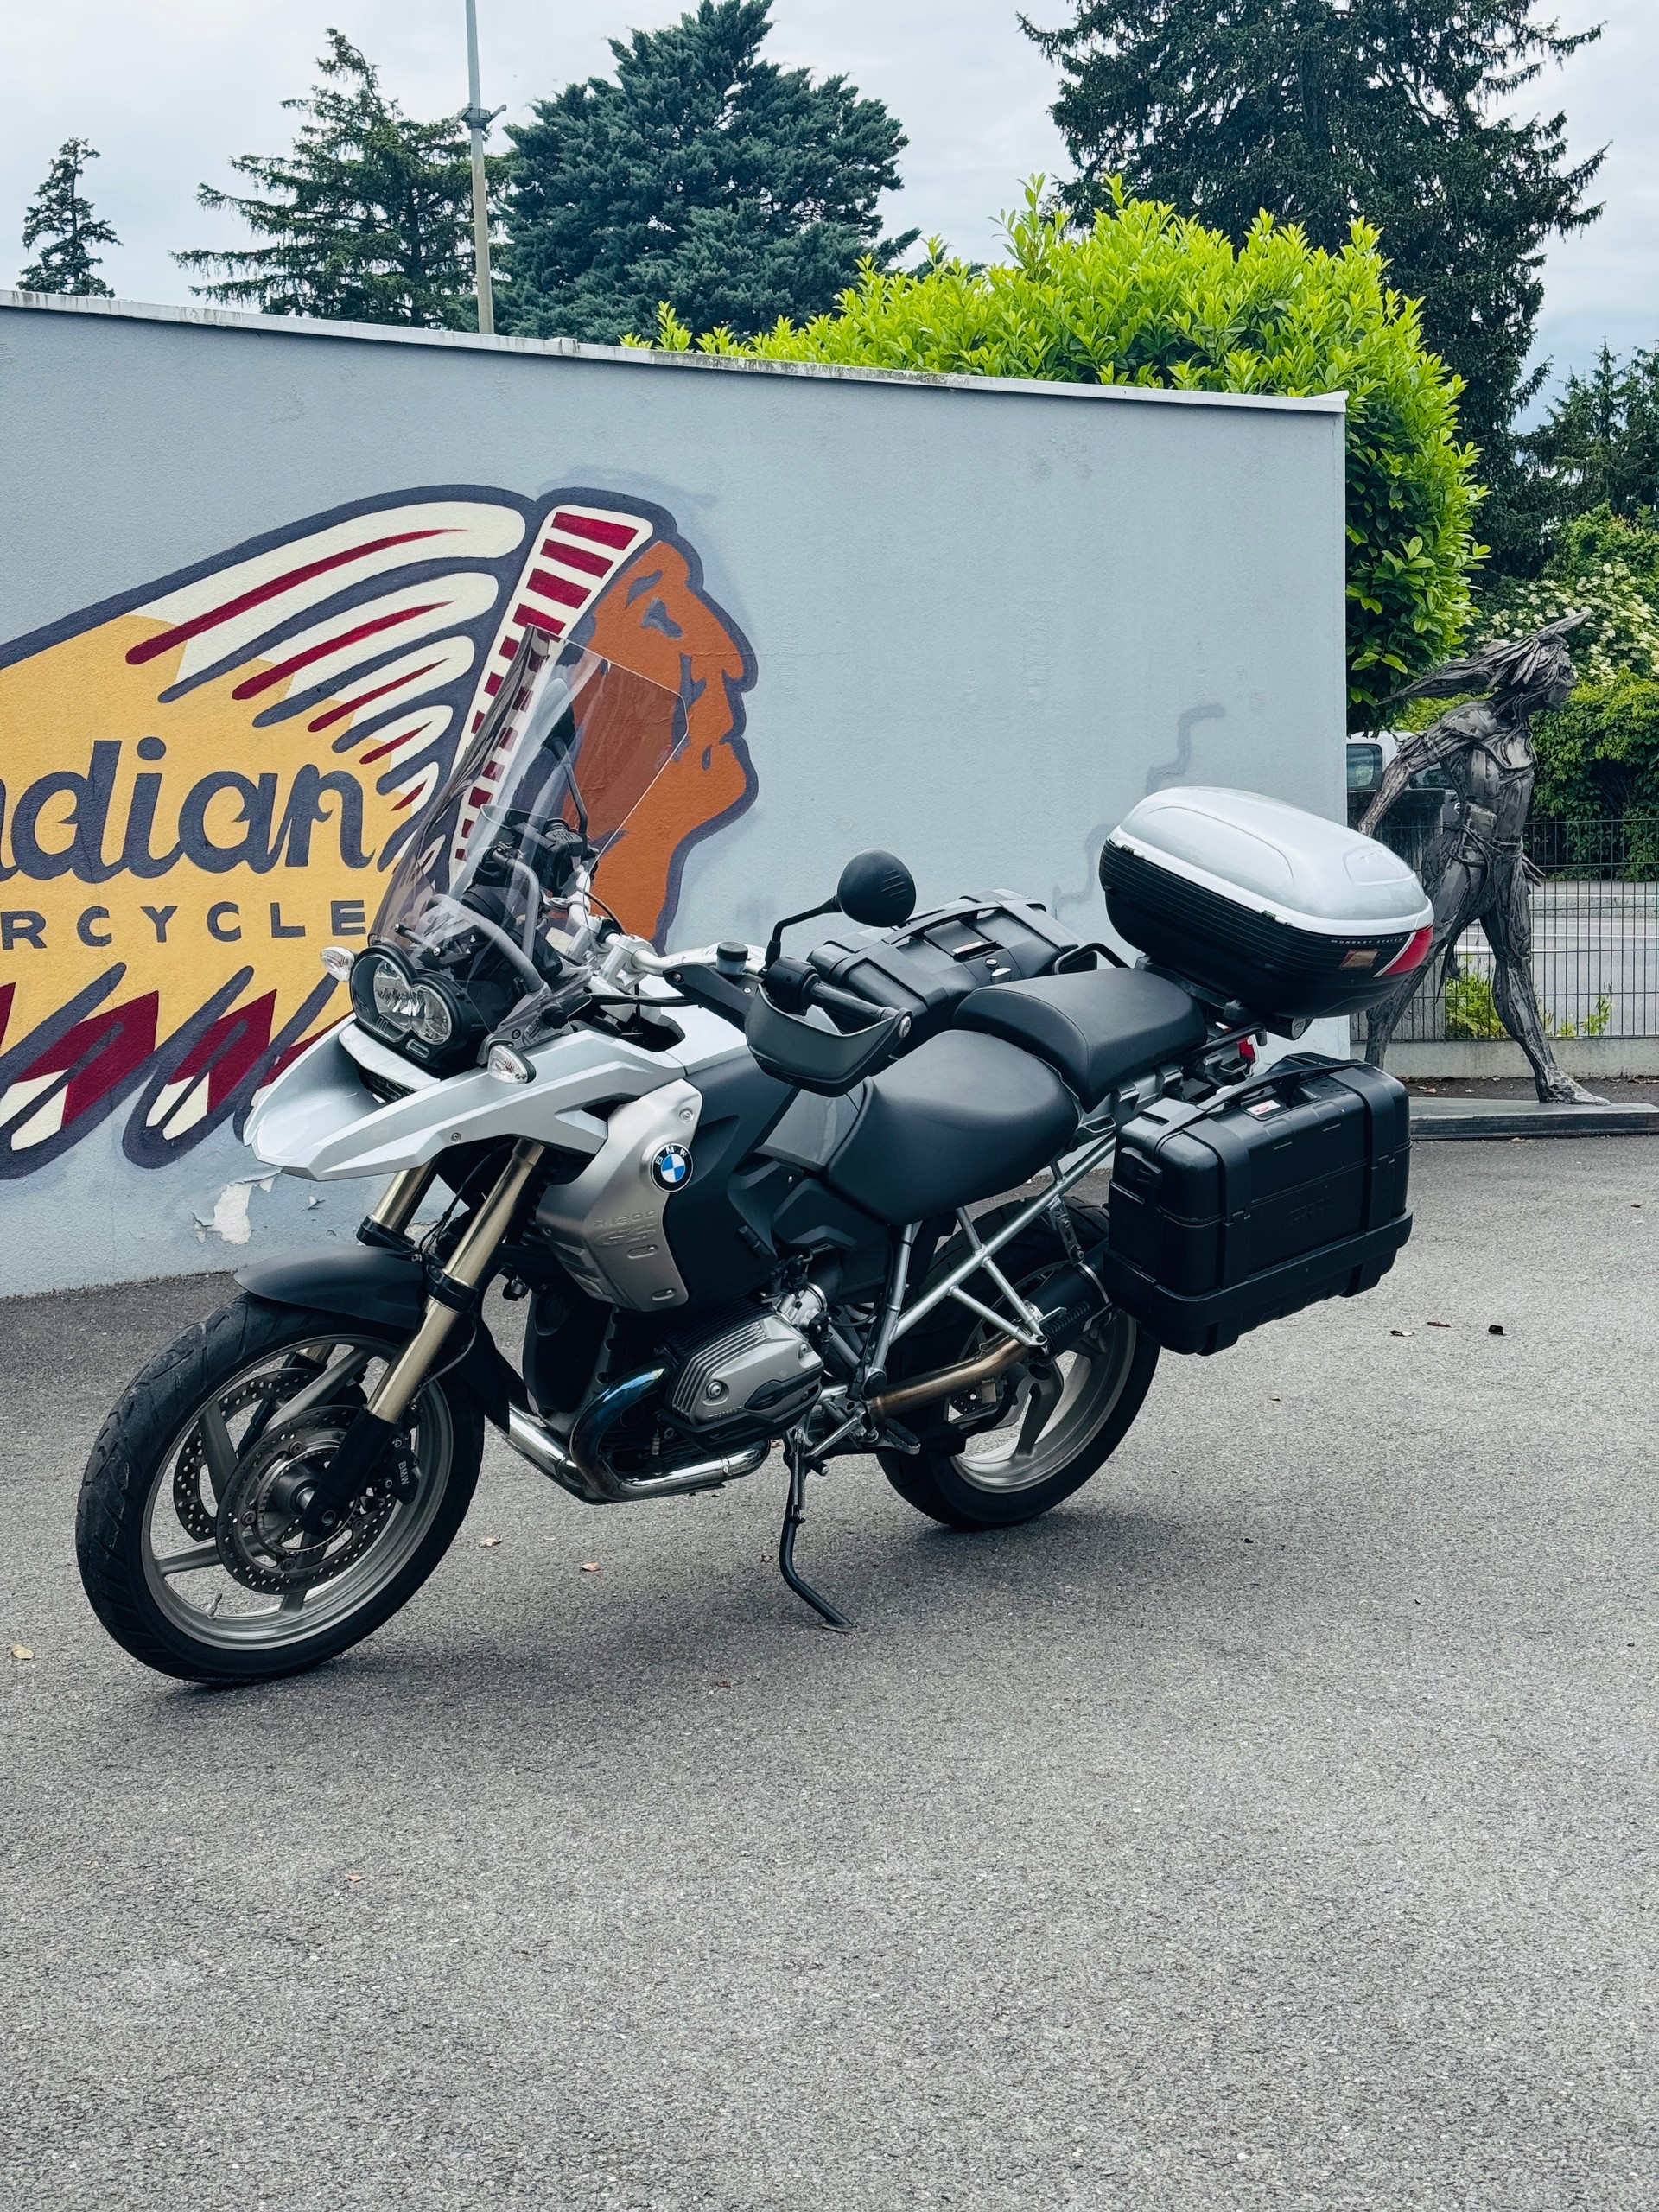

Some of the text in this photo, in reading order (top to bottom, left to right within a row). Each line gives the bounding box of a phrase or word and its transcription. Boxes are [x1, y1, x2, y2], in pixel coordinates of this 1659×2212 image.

[0, 737, 375, 884] dian
[655, 1146, 688, 1166] BMW
[398, 1460, 410, 1485] BMW
